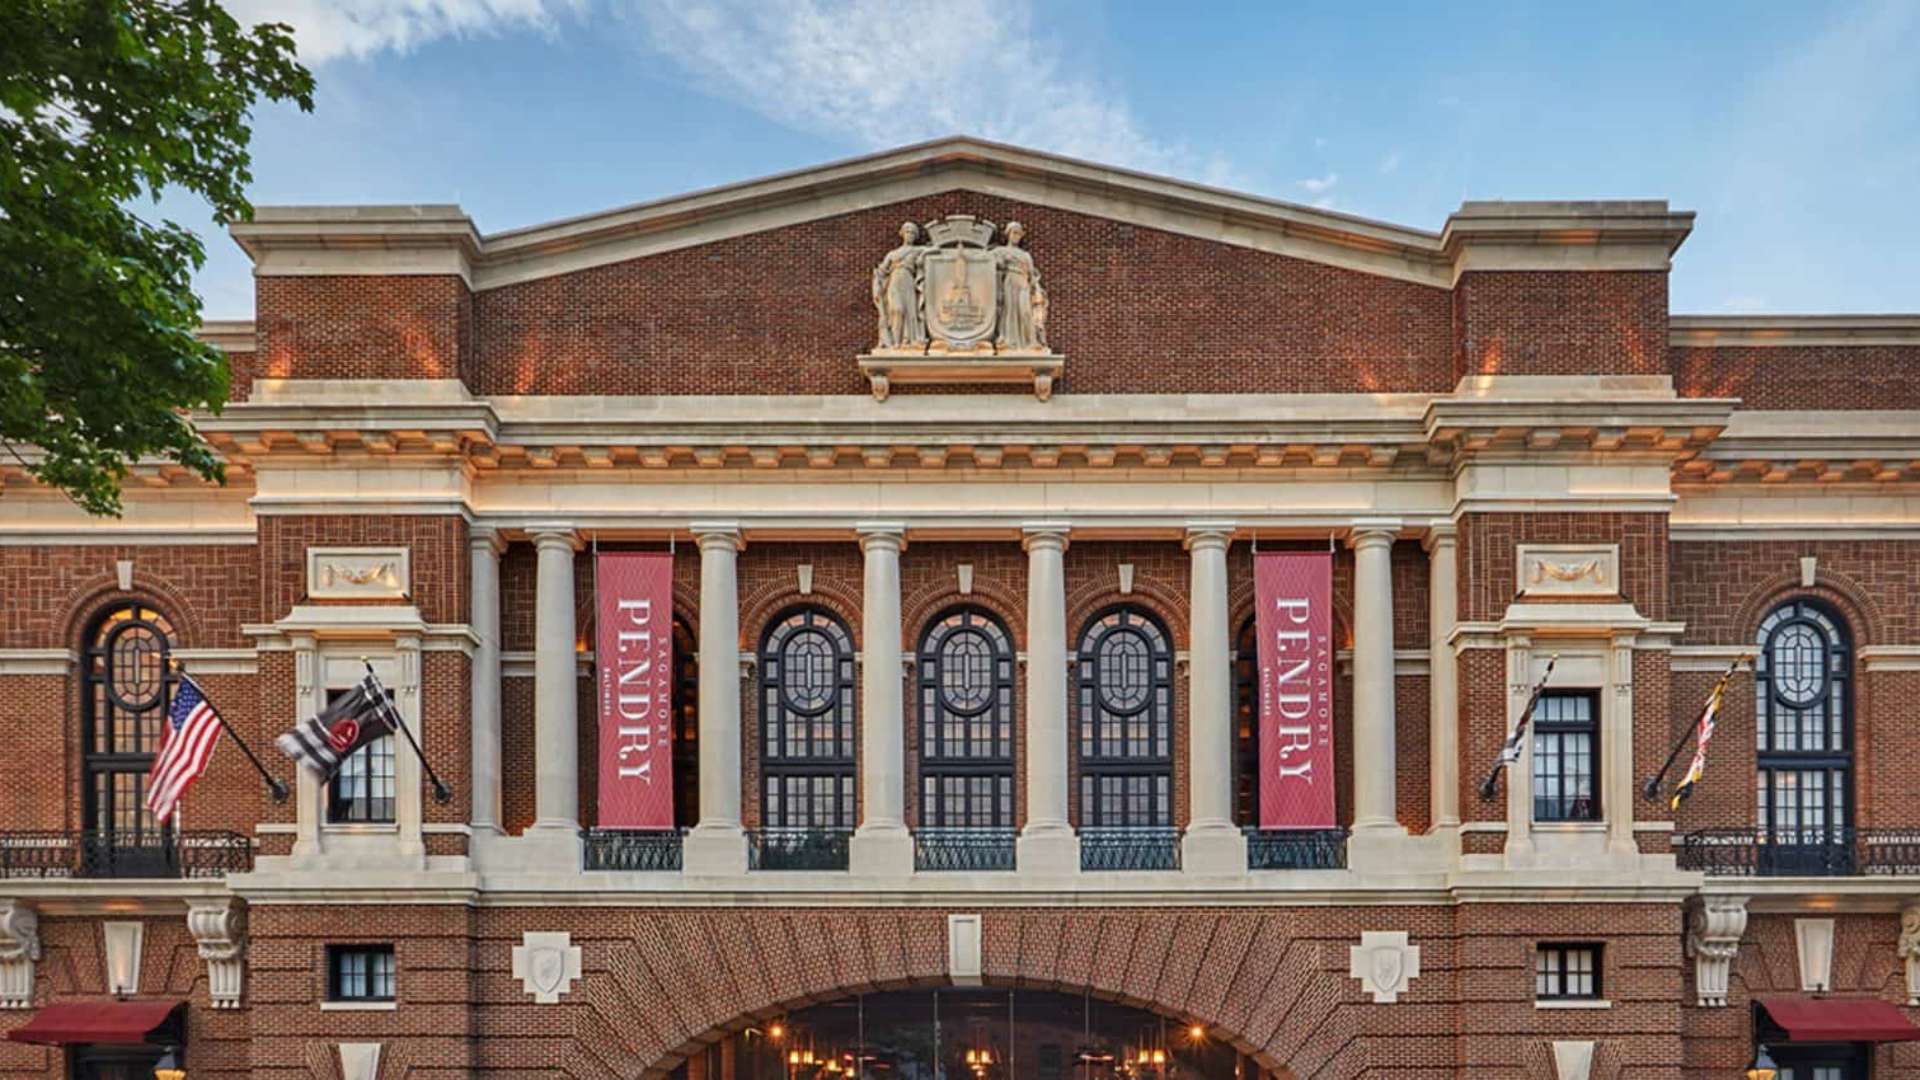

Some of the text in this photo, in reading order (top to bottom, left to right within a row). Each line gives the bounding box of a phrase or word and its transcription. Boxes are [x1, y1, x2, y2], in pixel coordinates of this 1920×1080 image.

[618, 599, 650, 785] PENDRY
[657, 636, 667, 747] SAGAMORE
[1277, 597, 1312, 785] PENDRY
[1317, 635, 1328, 747] SAGAMORE
